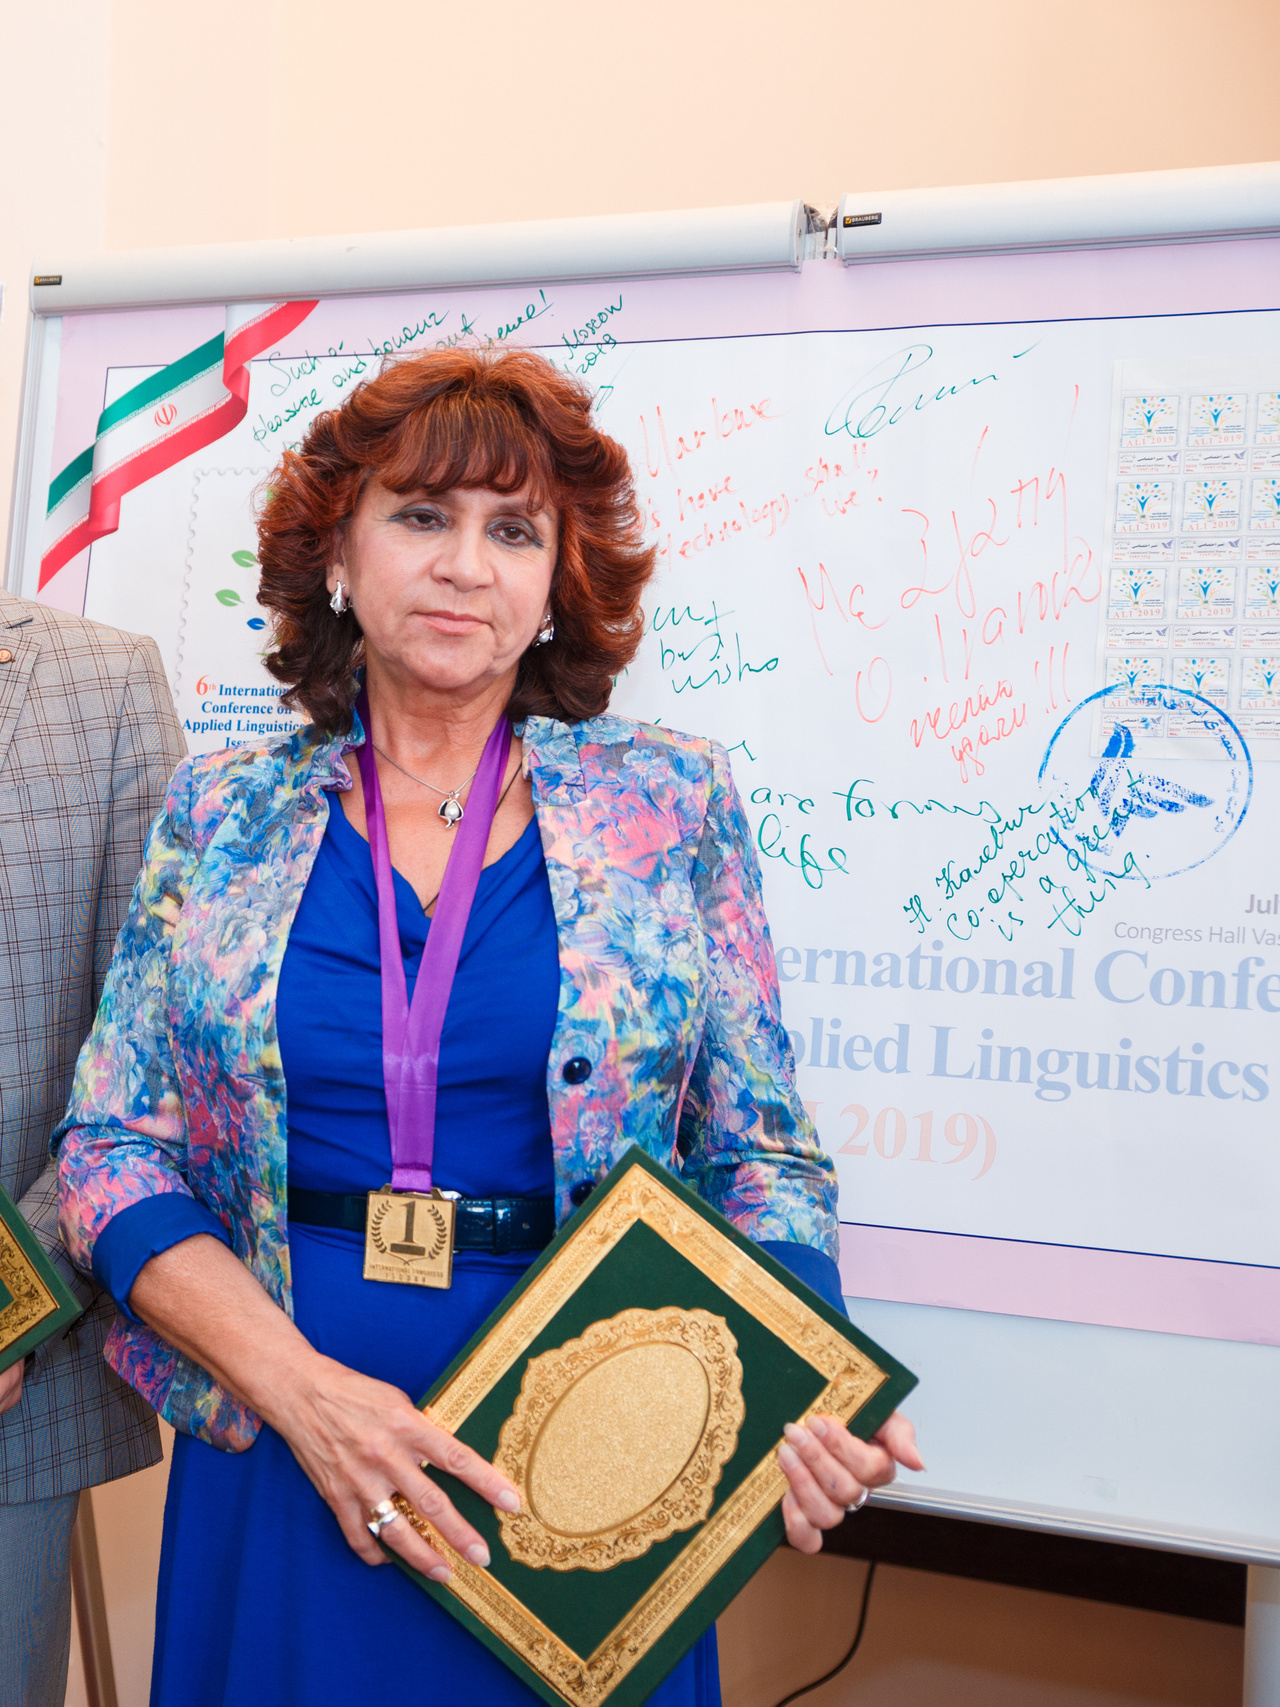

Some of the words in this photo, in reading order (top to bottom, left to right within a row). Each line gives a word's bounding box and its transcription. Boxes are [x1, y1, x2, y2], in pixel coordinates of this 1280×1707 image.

[332, 352, 368, 388] and
[1127, 439, 1146, 448] ALI
[1152, 435, 1174, 445] 2019
[1192, 438, 1212, 447] ALI
[1218, 434, 1242, 444] 2019
[1120, 525, 1140, 533] ALI
[1144, 522, 1168, 531] 2019
[1188, 523, 1208, 531] ALI
[1213, 520, 1236, 529] 2019
[1113, 610, 1133, 619] ALI
[1137, 608, 1161, 617] 2019
[1182, 610, 1202, 618] ALI
[1207, 608, 1231, 617] 2019
[195, 674, 217, 696] 6th
[201, 701, 274, 715] Conference
[182, 718, 233, 734] Applied
[236, 719, 305, 736] Linguistics
[750, 786, 815, 816] are
[757, 813, 850, 890] life
[1114, 921, 1203, 945] Congress
[1209, 926, 1246, 944] Hall
[925, 1024, 1270, 1103] Linguistics
[836, 1103, 998, 1182] 2019)
[399, 1200, 418, 1245] 1
